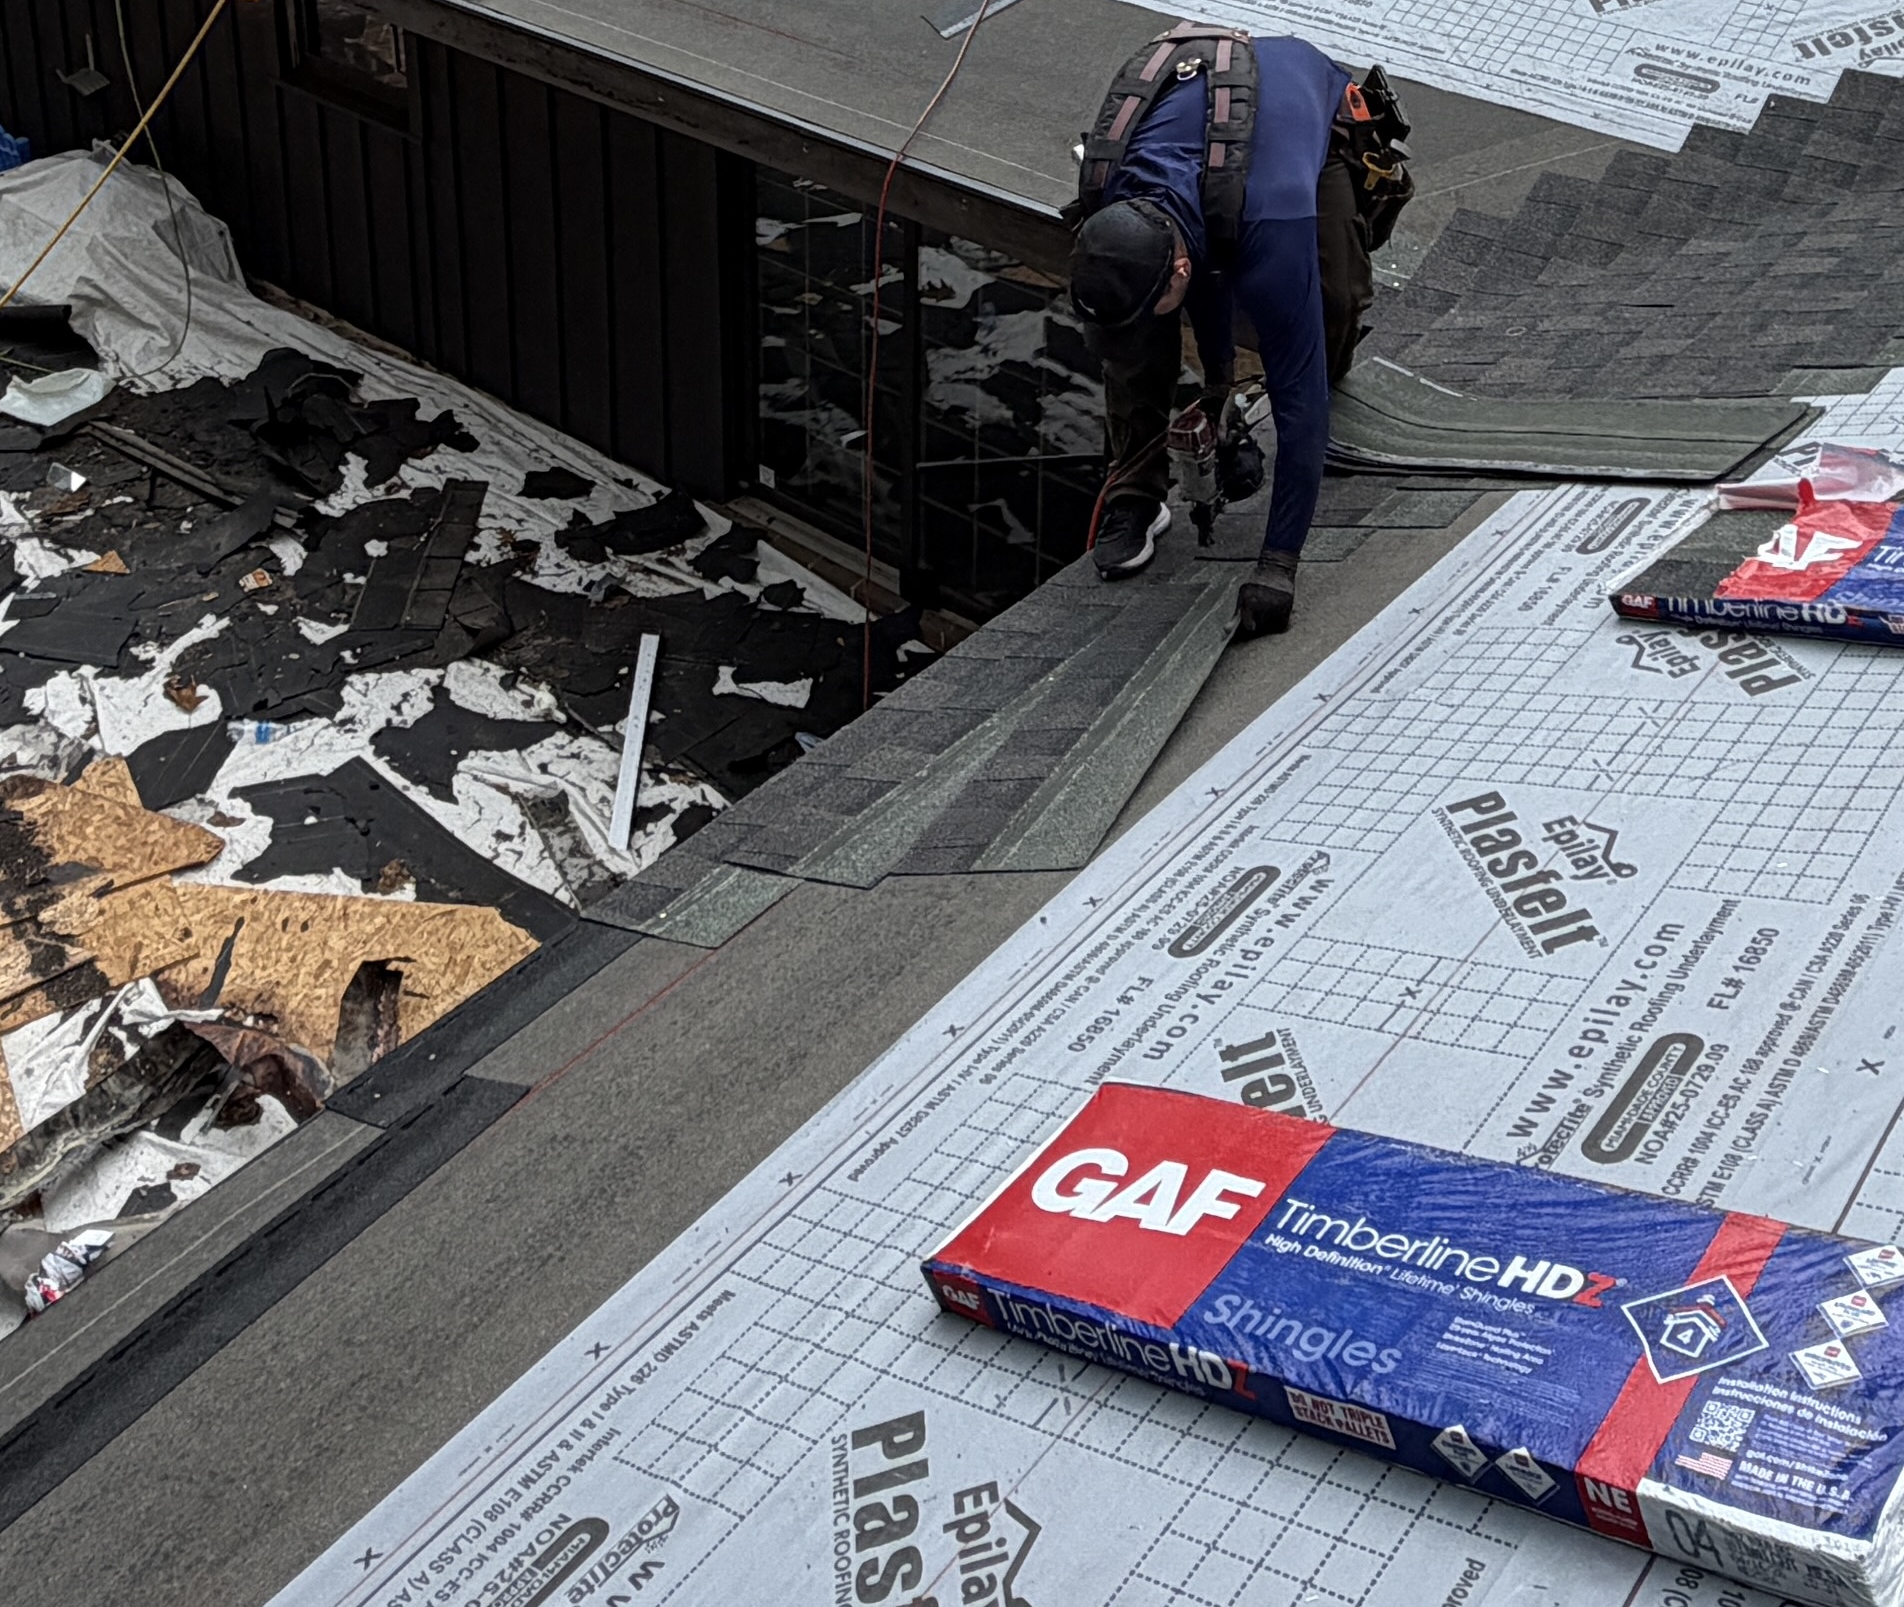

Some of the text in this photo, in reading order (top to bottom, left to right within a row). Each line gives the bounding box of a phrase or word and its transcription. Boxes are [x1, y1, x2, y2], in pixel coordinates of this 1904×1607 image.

[1654, 42, 1811, 87] www.epilay.com
[1622, 595, 1655, 609] GAF
[1541, 815, 1611, 881] Epilay
[1446, 790, 1600, 955] Plasfelt
[1142, 879, 1336, 1062] www.epilay.com
[1706, 927, 1780, 1011] FL# 16850
[1506, 922, 1684, 1139] www.epilay.com
[1536, 898, 1742, 1169] rotecTite Synthetic Roofing Underlayment
[1635, 1044, 1730, 1164] NOA#25-0729.09
[1032, 1147, 1266, 1236] GAF
[942, 1284, 980, 1310] GAF
[1265, 1234, 1535, 1315] High Shingles
[697, 1290, 736, 1320] Meets
[1203, 1292, 1402, 1376] Shingles
[631, 1361, 659, 1385] 226
[600, 1383, 636, 1412] Type
[1311, 1398, 1336, 1414] NOT
[1340, 1405, 1384, 1428] TRIPLE
[1712, 1386, 1795, 1415] Instrucciones
[1797, 1408, 1814, 1420] de
[1718, 1377, 1862, 1425] Installation Instructions
[1296, 1406, 1390, 1444] STACK PALLETS
[517, 1448, 561, 1489] ASTM
[830, 1434, 853, 1525] SYNTHETIC
[1739, 1461, 1775, 1481] MADE
[1775, 1472, 1790, 1484] IN
[1791, 1476, 1815, 1492] THE
[434, 1427, 622, 1604] Intertek CCRR# 1004 ICC-ES
[485, 1487, 523, 1522] E108
[1585, 1478, 1632, 1514] NE
[428, 1519, 487, 1574] (CLASS
